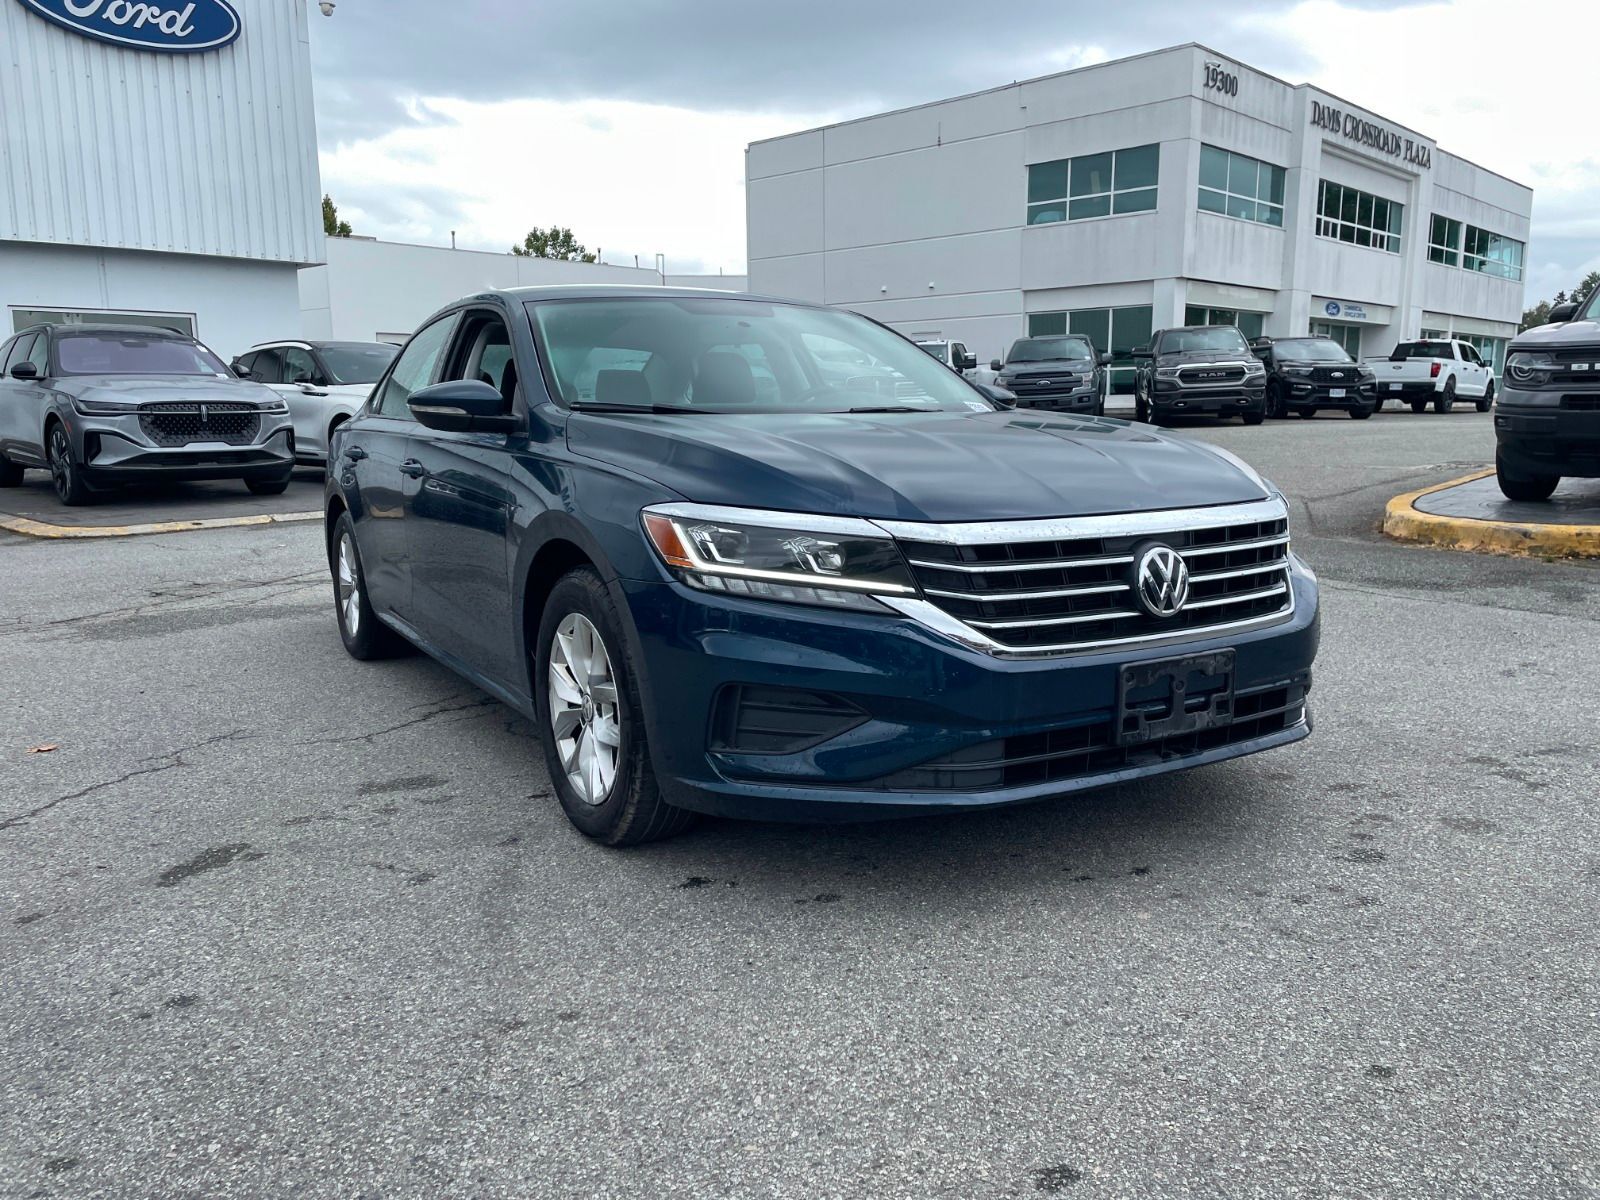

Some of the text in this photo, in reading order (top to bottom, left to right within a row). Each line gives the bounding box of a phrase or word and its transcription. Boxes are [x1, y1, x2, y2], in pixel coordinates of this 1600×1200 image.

[1203, 66, 1238, 96] 19300
[1310, 101, 1431, 169] DAMS CROSSROADS PLAZA
